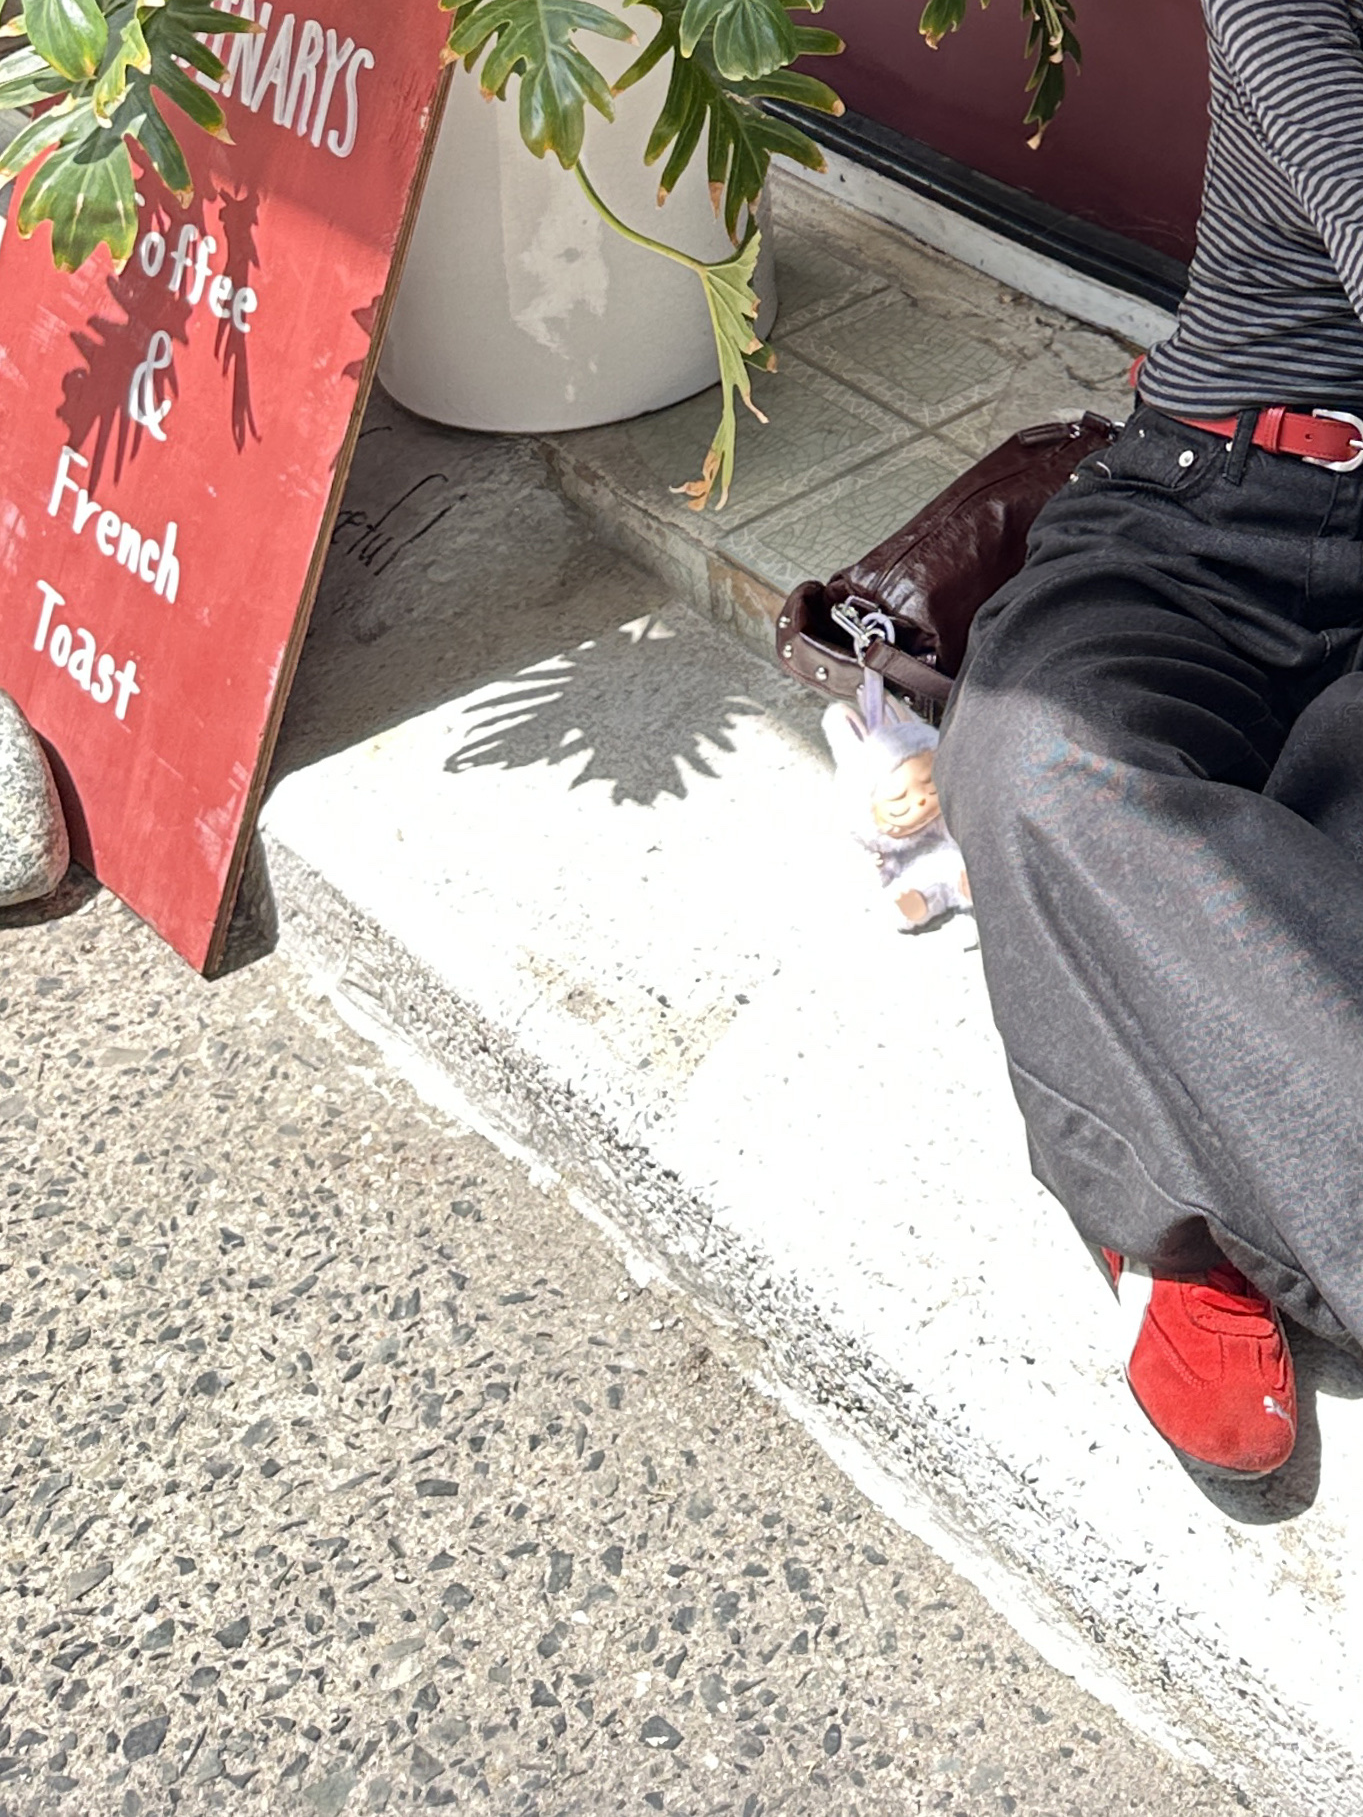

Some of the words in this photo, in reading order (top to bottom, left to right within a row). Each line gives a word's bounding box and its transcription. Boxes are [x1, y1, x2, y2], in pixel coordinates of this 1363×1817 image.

[135, 191, 258, 333] offee
[129, 329, 173, 442] &
[47, 445, 181, 605] French
[33, 579, 141, 721] Toast
